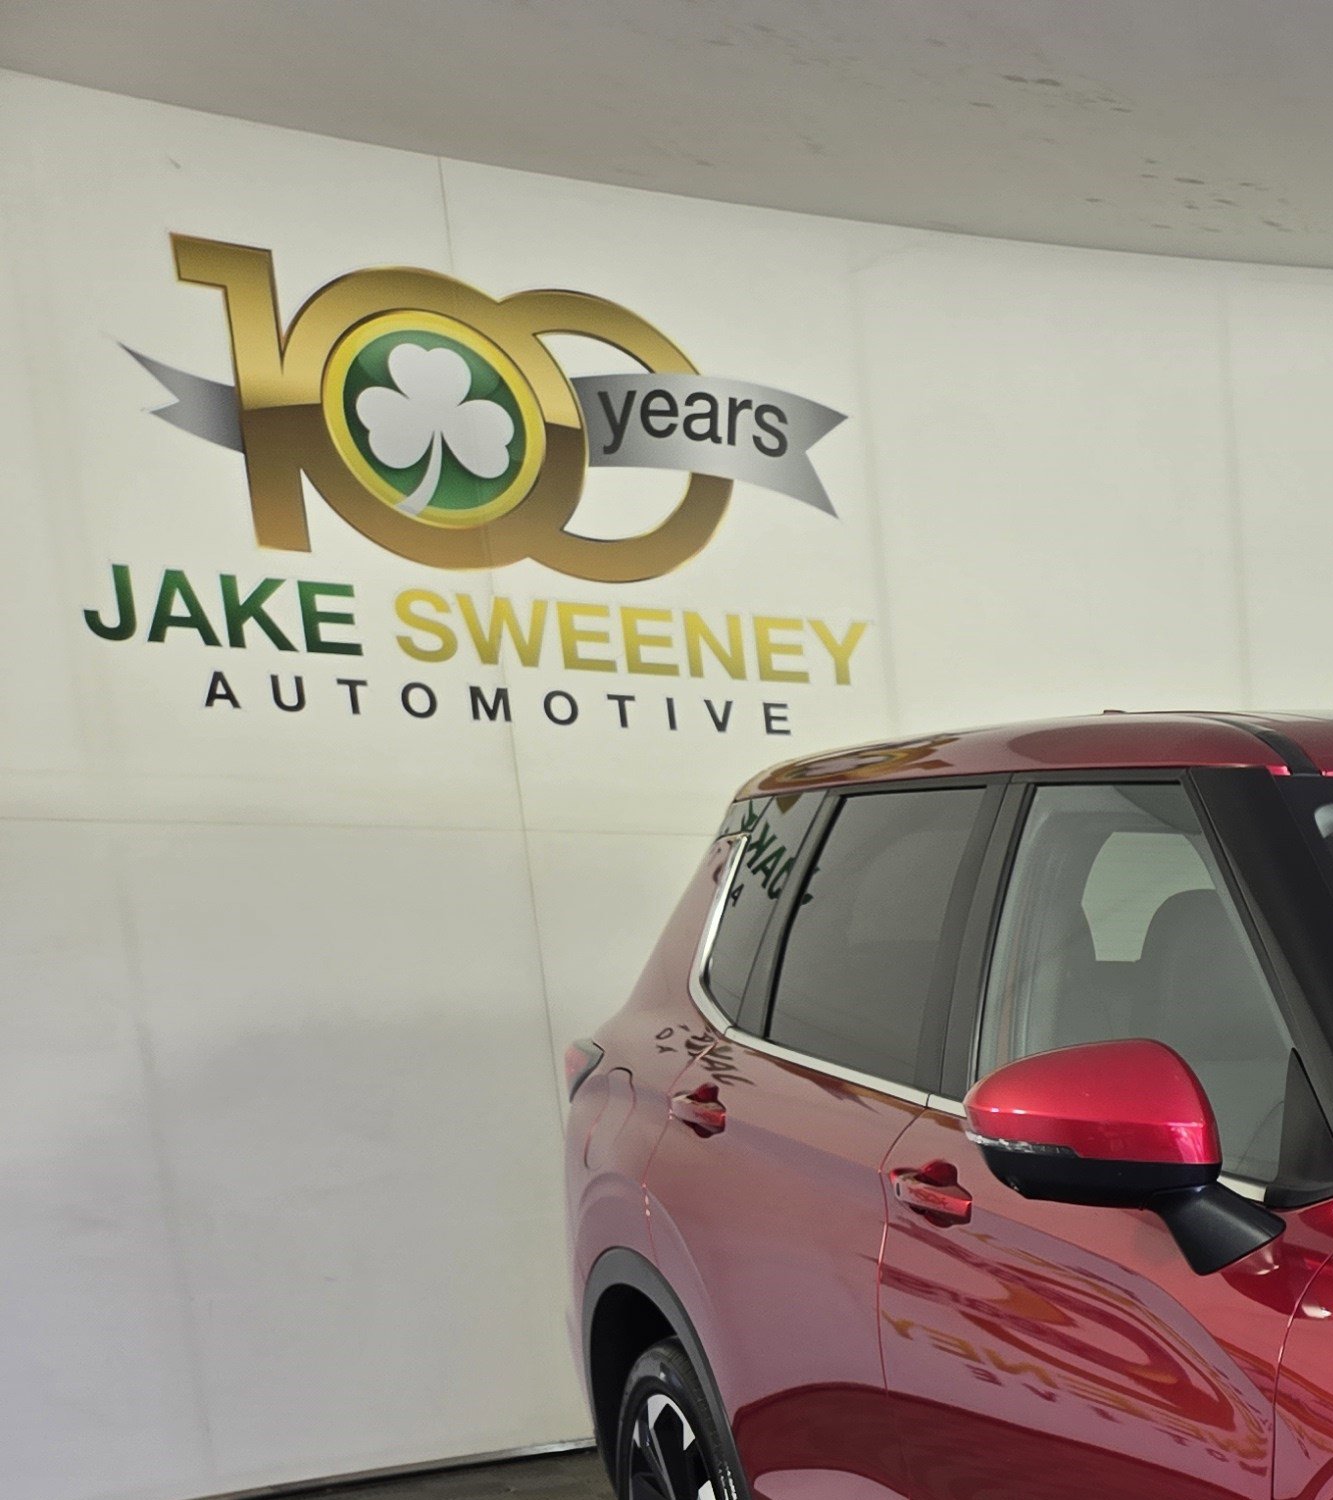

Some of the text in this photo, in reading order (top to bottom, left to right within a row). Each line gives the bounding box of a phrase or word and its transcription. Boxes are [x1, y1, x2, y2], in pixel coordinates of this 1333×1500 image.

[169, 231, 790, 584] 100 years
[84, 563, 869, 685] JAKE SWEENEY
[204, 670, 792, 736] AUTOMOTIVE
